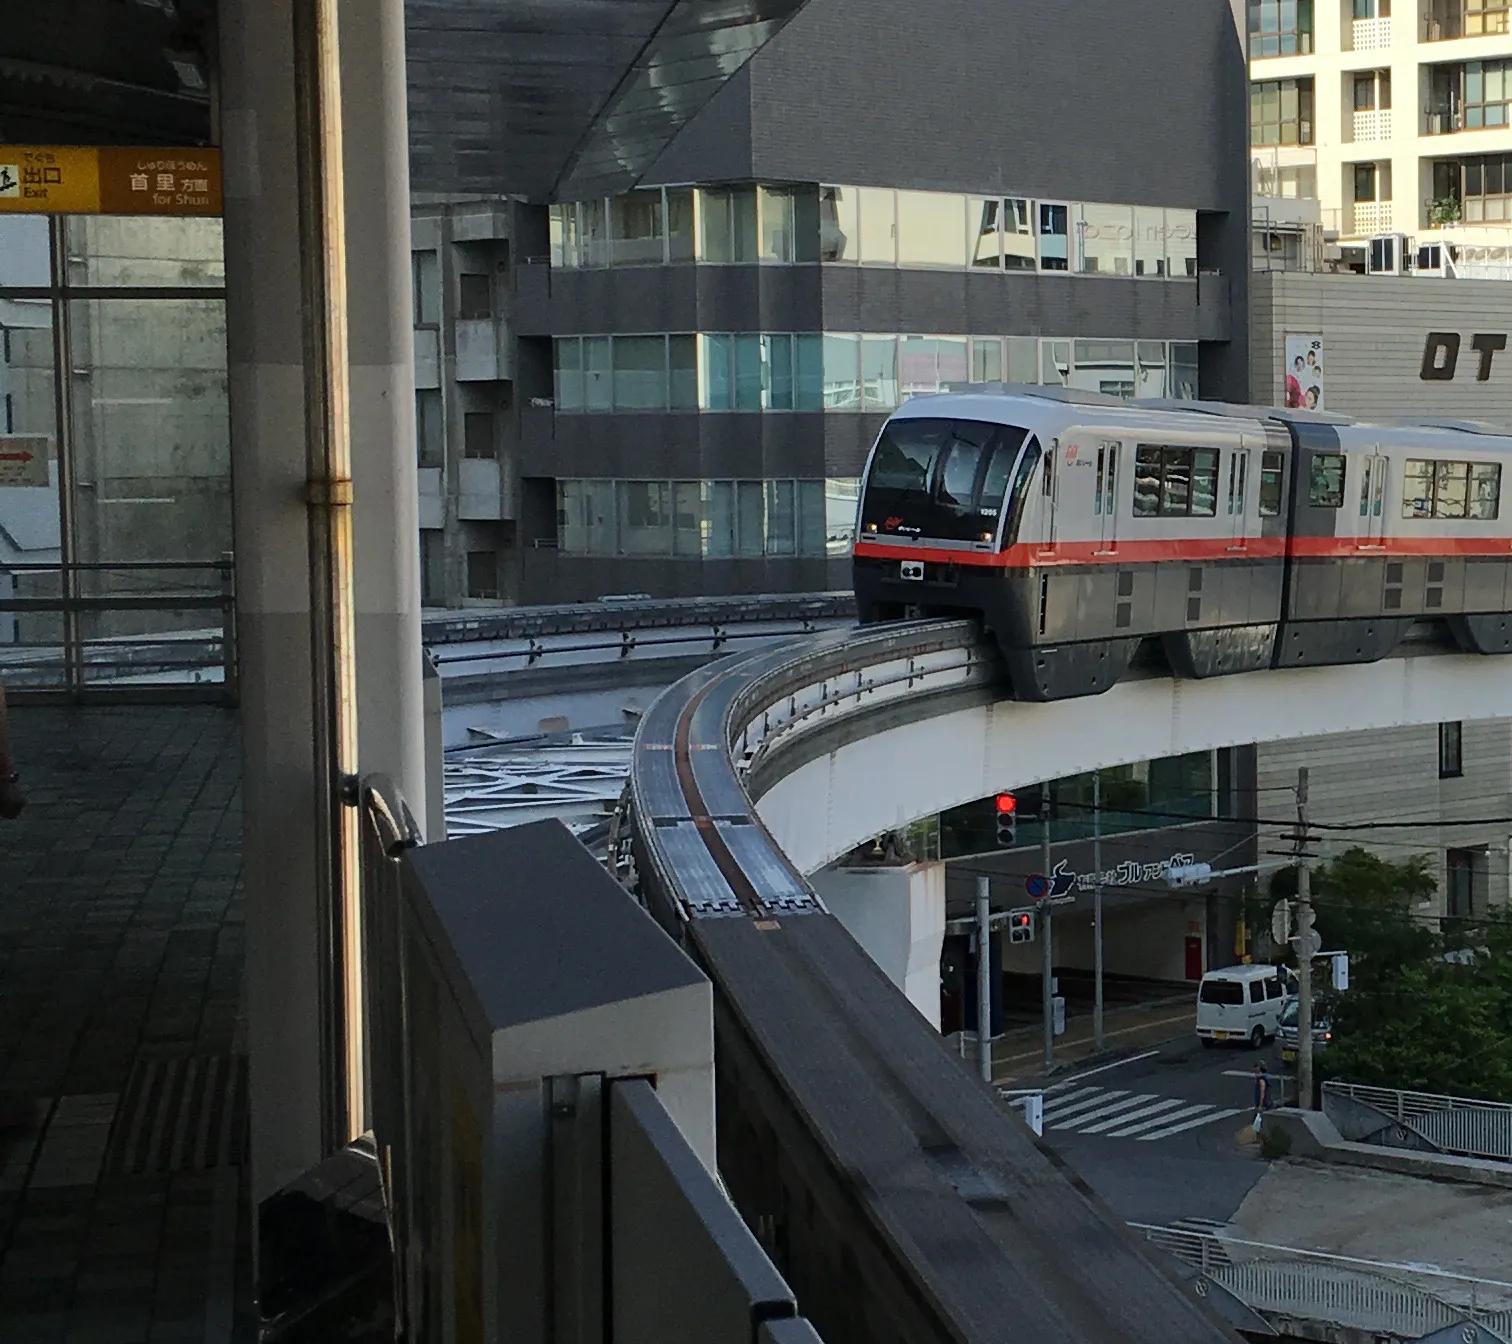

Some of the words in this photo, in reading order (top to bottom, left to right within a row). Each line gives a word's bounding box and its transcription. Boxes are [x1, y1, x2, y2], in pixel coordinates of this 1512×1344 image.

[24, 167, 61, 184] 出口
[24, 188, 48, 198] Exit
[153, 195, 171, 205] for
